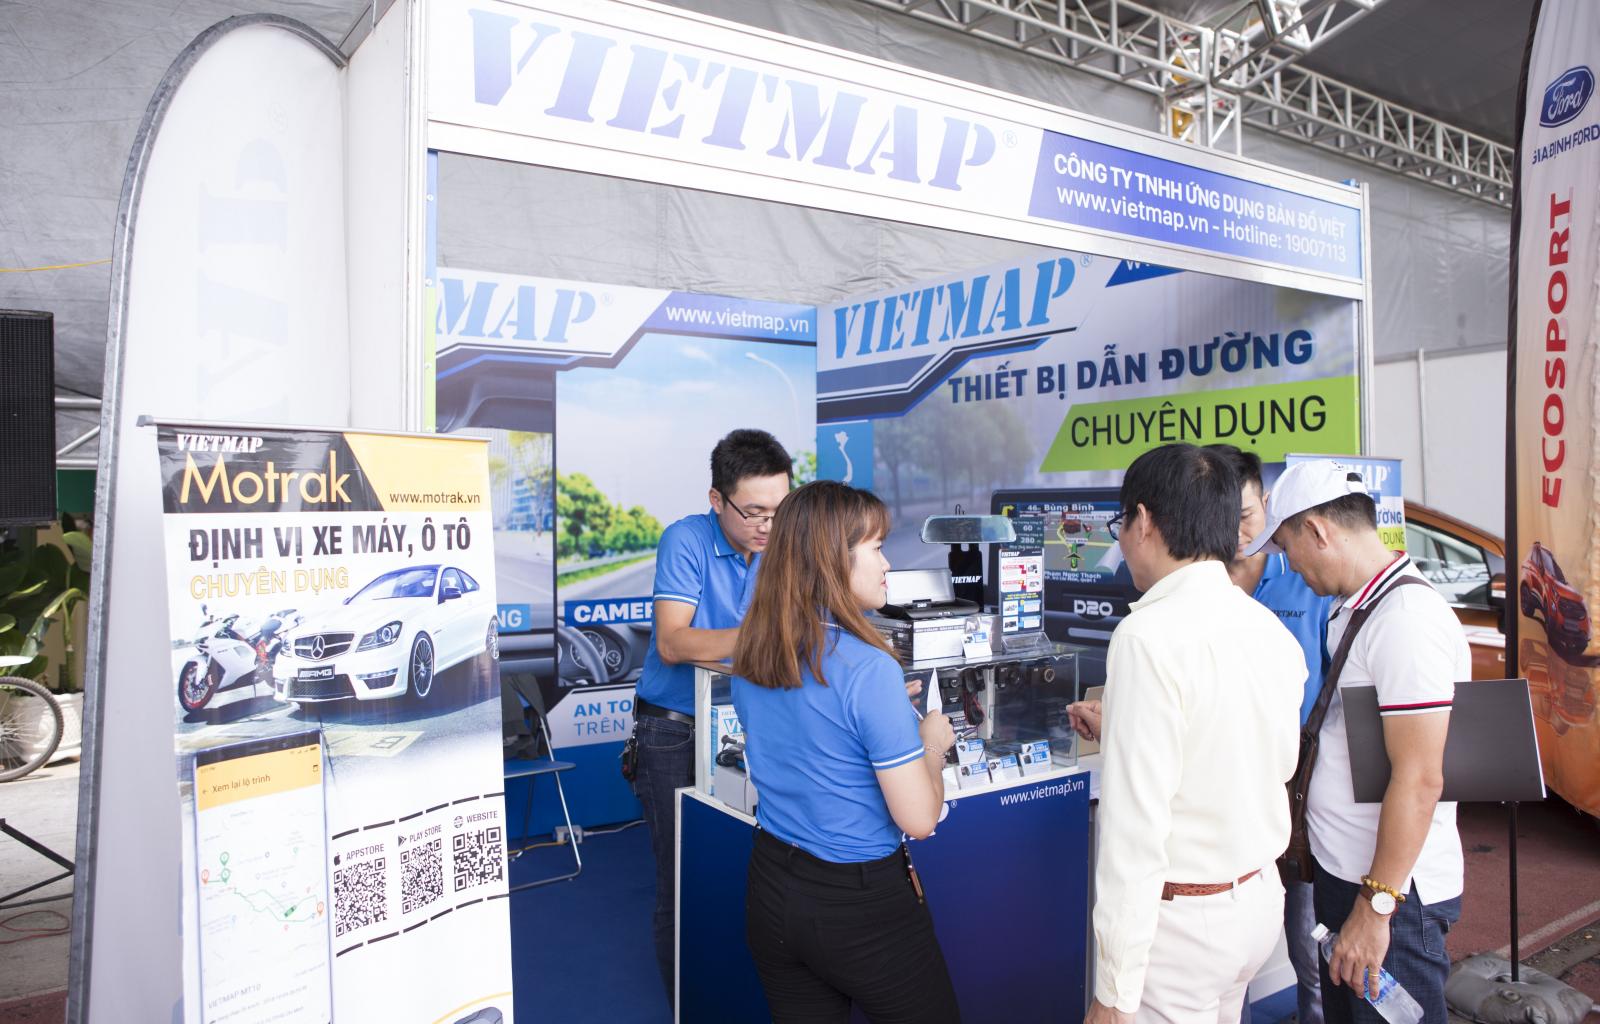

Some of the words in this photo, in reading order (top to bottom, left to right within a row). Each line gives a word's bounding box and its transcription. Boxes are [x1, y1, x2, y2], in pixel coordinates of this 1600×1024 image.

[468, 8, 996, 191] VIETMAP
[1548, 77, 1585, 120] Ford
[1573, 124, 1600, 148] FORD
[1054, 152, 1107, 184] CÔNG
[1110, 166, 1135, 189] TY
[1135, 172, 1182, 202] TNHH
[1186, 181, 1220, 211] ỨNG
[1223, 197, 1264, 223] DỤNG
[1319, 215, 1346, 240] VIỆT
[1057, 186, 1209, 233] www.vietmap.vn
[1223, 221, 1282, 249] Hotline:
[1286, 233, 1346, 263] 19007113
[665, 303, 809, 334] www.vietmap.vn
[835, 256, 1076, 359] VIETMAP
[1541, 192, 1571, 508] ECOSPORT
[948, 361, 1029, 404] THIẾT
[1037, 365, 1067, 401] BỊ
[1077, 343, 1147, 388] DẪN
[1159, 329, 1313, 380] ĐƯỜNG
[1072, 401, 1203, 448] CHUYÊN
[1216, 395, 1327, 446] DỤNG
[176, 433, 263, 454] VIETMAP
[180, 450, 352, 505] Motrak
[389, 490, 481, 505] www.motrak.vn
[188, 527, 264, 568] ĐỊNH
[274, 525, 302, 564] VỊ
[313, 524, 342, 556] XE
[353, 517, 413, 558] MÁY,
[421, 517, 437, 551] Ô
[443, 517, 471, 550] TÔ
[190, 566, 287, 600] CHUYÊN
[294, 566, 349, 597] DỤNG
[951, 575, 981, 583] VIETMAP
[1074, 599, 1113, 616] D20
[574, 702, 601, 717] AN
[606, 700, 632, 713] TO
[574, 718, 625, 737] TRÊN
[212, 783, 230, 793] Xem
[1000, 778, 1084, 806] www.vietmap.vn
[466, 811, 498, 824] WEBSITE
[409, 829, 424, 843] PLAY
[424, 824, 442, 839] STORE
[346, 843, 385, 861] APPSTORE
